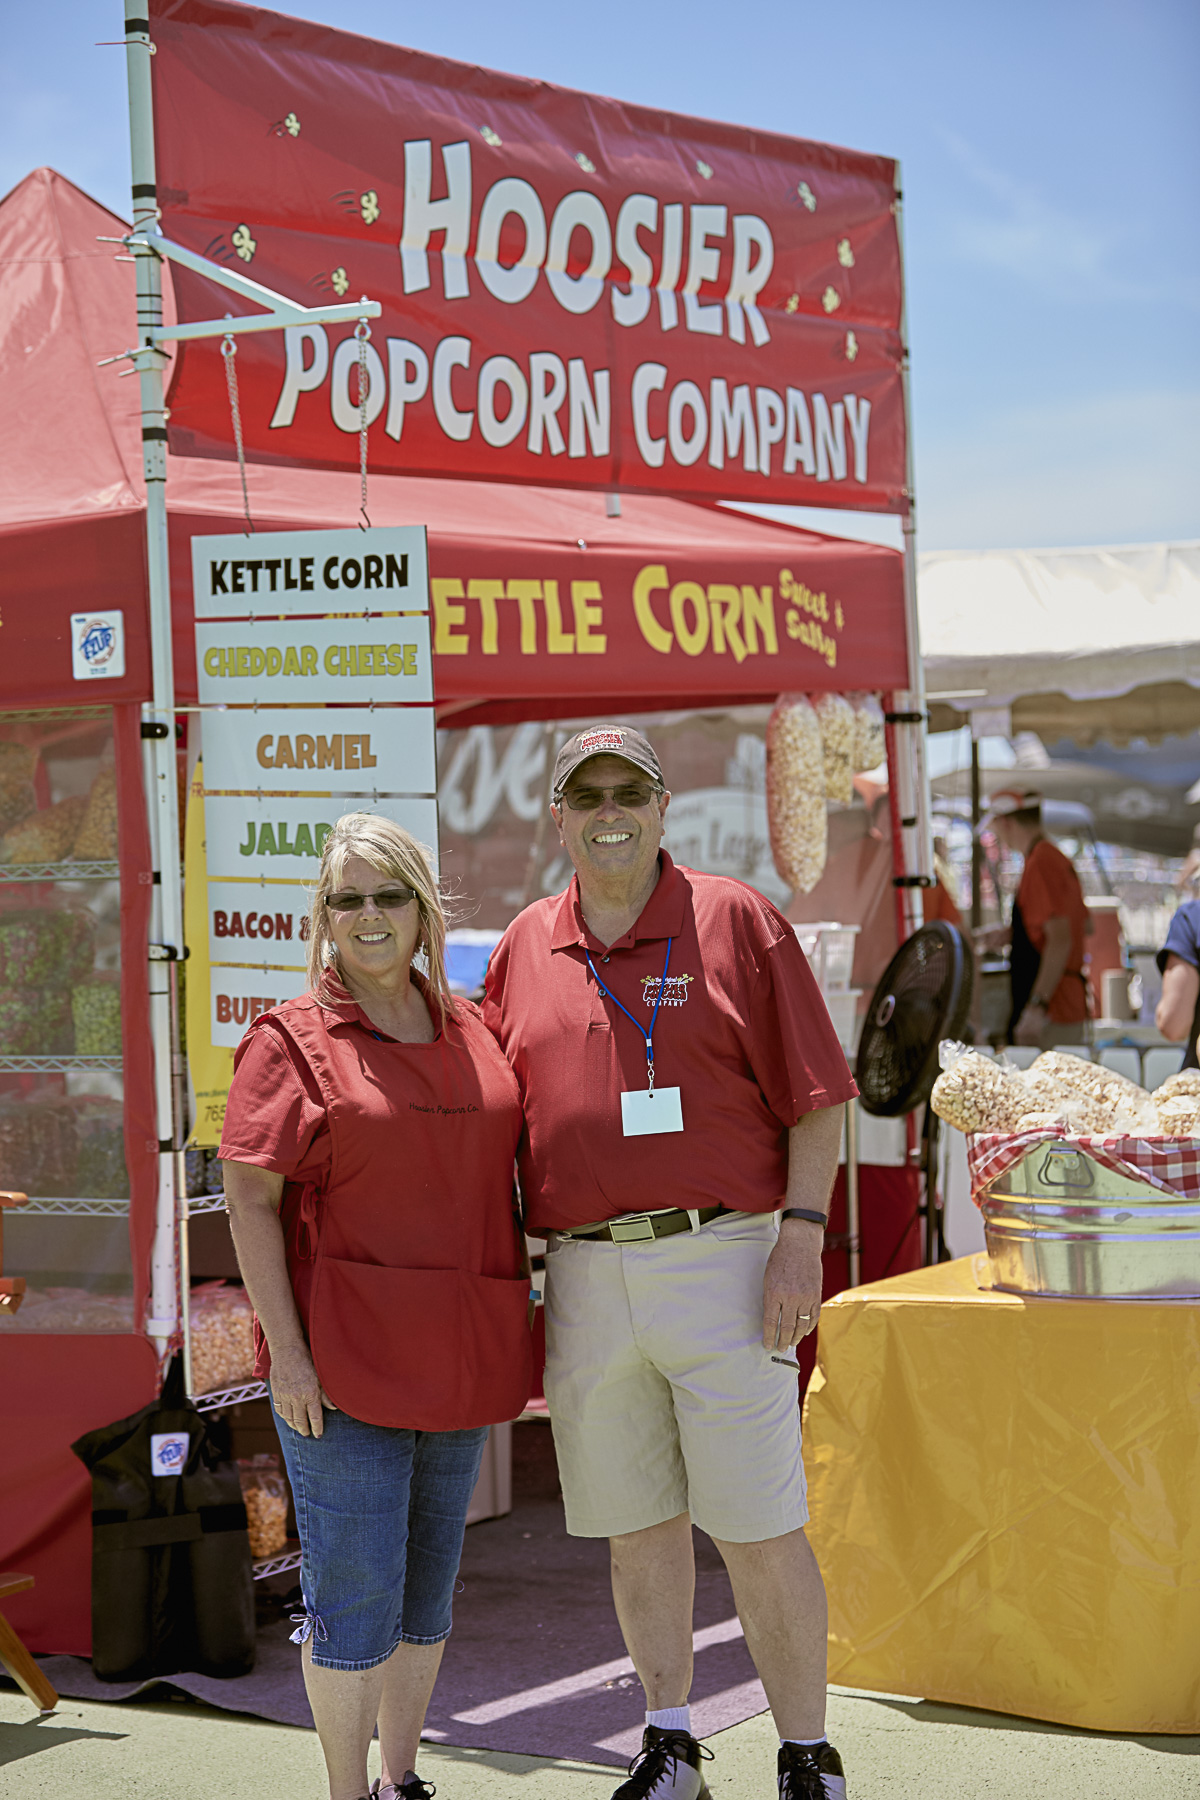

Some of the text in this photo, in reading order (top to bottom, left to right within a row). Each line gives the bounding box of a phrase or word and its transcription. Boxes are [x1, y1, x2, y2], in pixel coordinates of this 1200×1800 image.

[400, 138, 774, 348] HOOSIER
[269, 323, 872, 484] POPCORN COMPANY
[210, 553, 409, 596] KETTLE CORN
[430, 564, 779, 664] ETTLE CORN
[203, 644, 418, 678] CHEDDAR CHEESE
[256, 734, 377, 771] CARMEL
[214, 910, 293, 940] BACON
